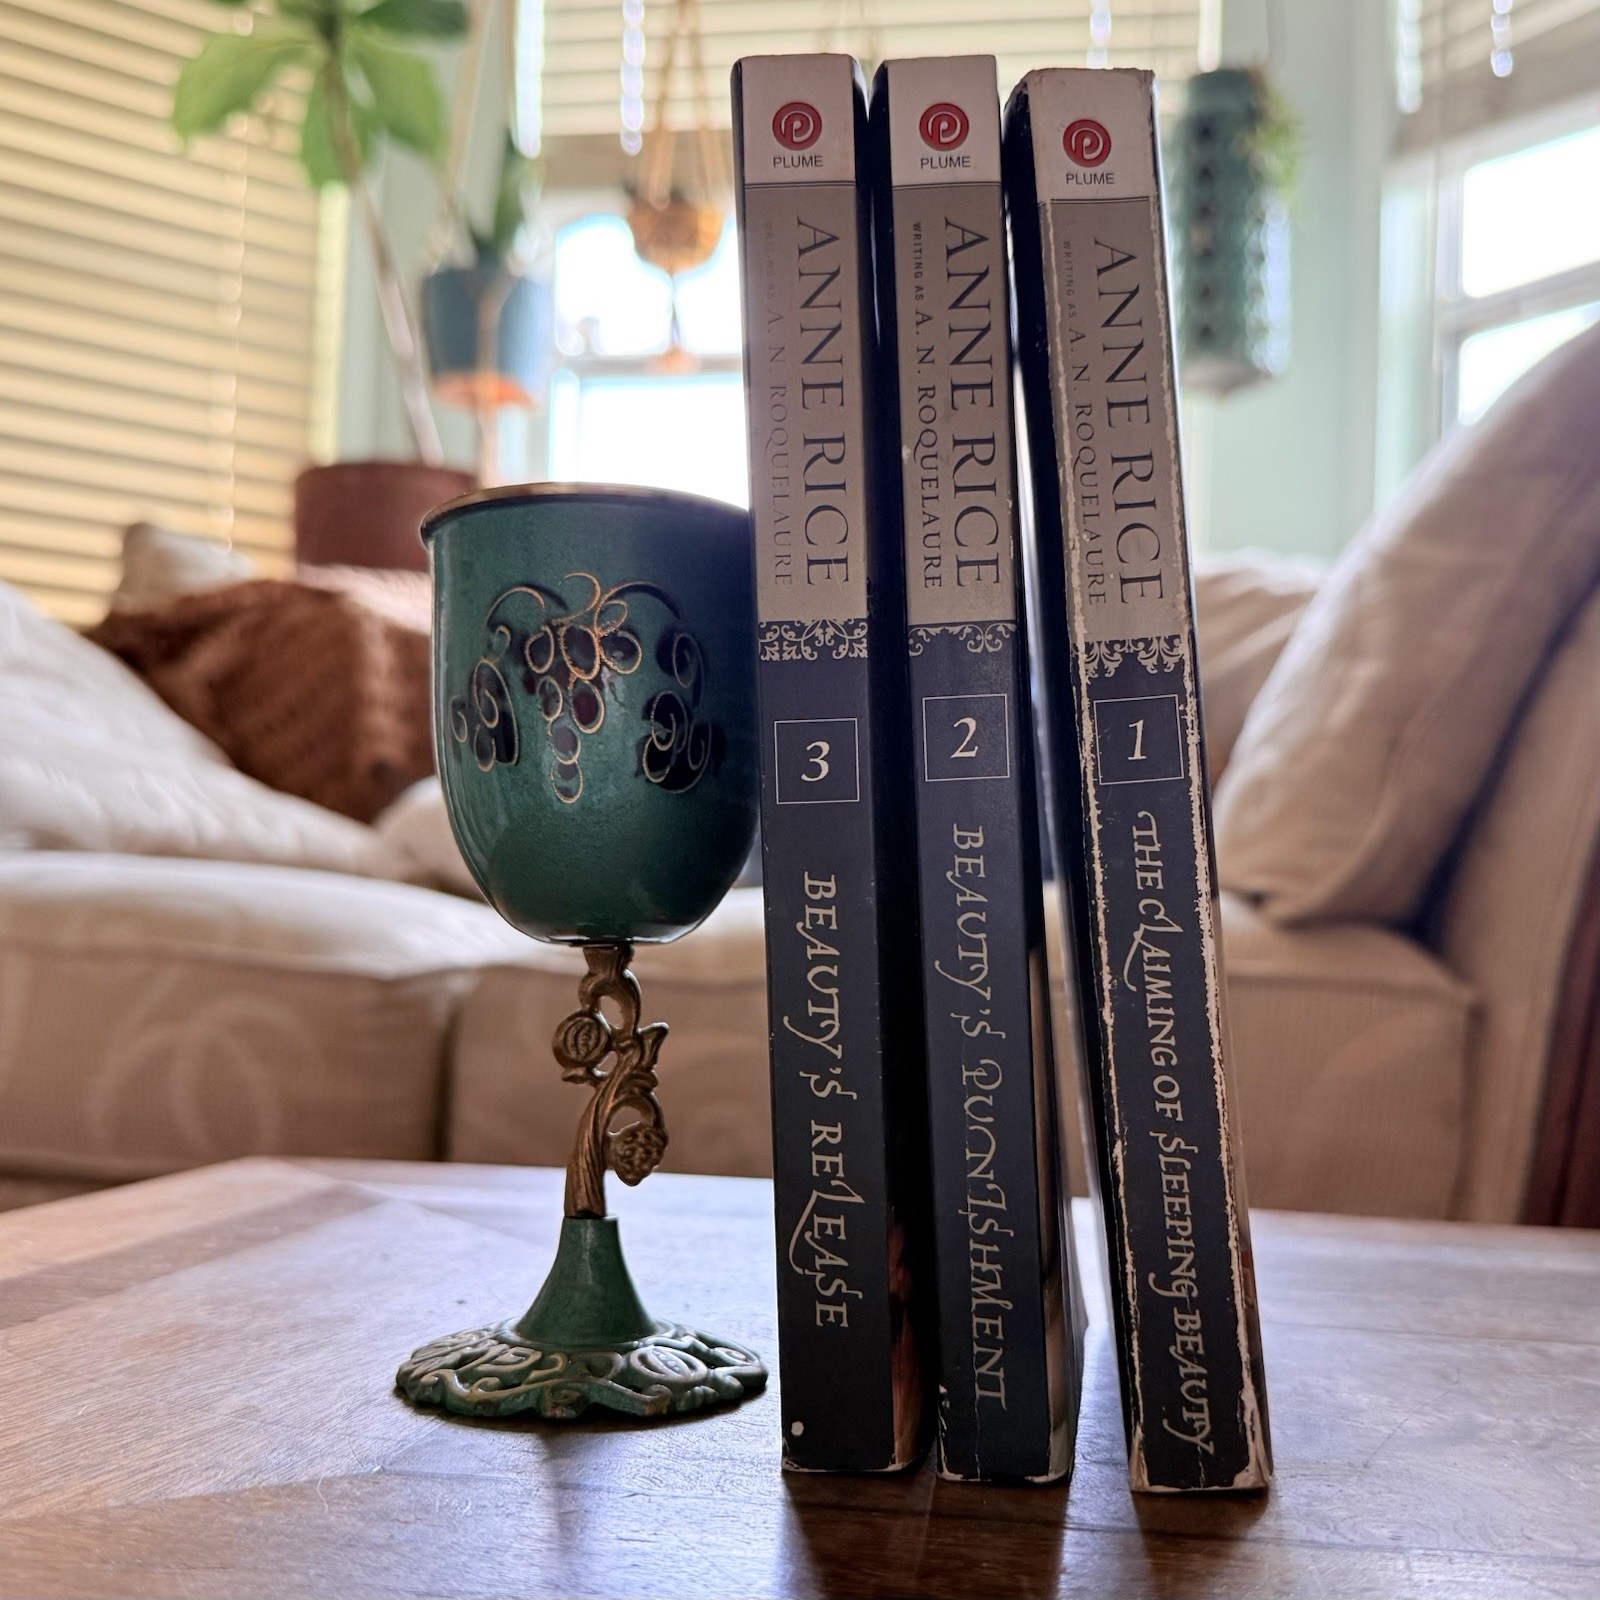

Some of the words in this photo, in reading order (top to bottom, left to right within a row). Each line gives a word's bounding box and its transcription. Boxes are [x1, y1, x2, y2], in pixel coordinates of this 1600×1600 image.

[773, 156, 823, 169] PLUME
[920, 156, 971, 169] PLUME
[1065, 172, 1115, 186] PLUME
[912, 222, 922, 280] WRITING
[1062, 240, 1075, 297] WRITING
[766, 312, 784, 334] A.
[797, 216, 845, 411] ANNE
[914, 286, 924, 302] AS
[915, 310, 933, 335] A.
[944, 217, 994, 411] ANNE
[1067, 303, 1077, 319] AS
[768, 346, 786, 375] N.
[916, 346, 935, 375] N.
[1068, 328, 1087, 353] A.
[1094, 238, 1150, 429] ANNE
[1072, 366, 1090, 392] N.
[764, 385, 793, 587] ROQUELAURE
[802, 432, 850, 586] RICE
[914, 385, 942, 588] ROQUELAURE
[952, 432, 1001, 588] RICE
[1073, 403, 1106, 605] ROQUELAURE
[1110, 450, 1165, 604] RICE
[801, 741, 831, 782] 3
[950, 717, 979, 758] 2
[1127, 719, 1148, 761] 1
[1132, 811, 1164, 891] THE
[935, 823, 1006, 1040] BEAUTY'S
[783, 871, 858, 1100] BEAUTY'S
[1123, 897, 1183, 1068] CLAIMING
[1153, 1075, 1183, 1122] OF
[789, 1119, 865, 1329] RELEASE
[958, 1058, 1014, 1411] PUNISHMENT
[1147, 1130, 1199, 1300] SLEEPING
[1163, 1308, 1214, 1454] BEAUTY
